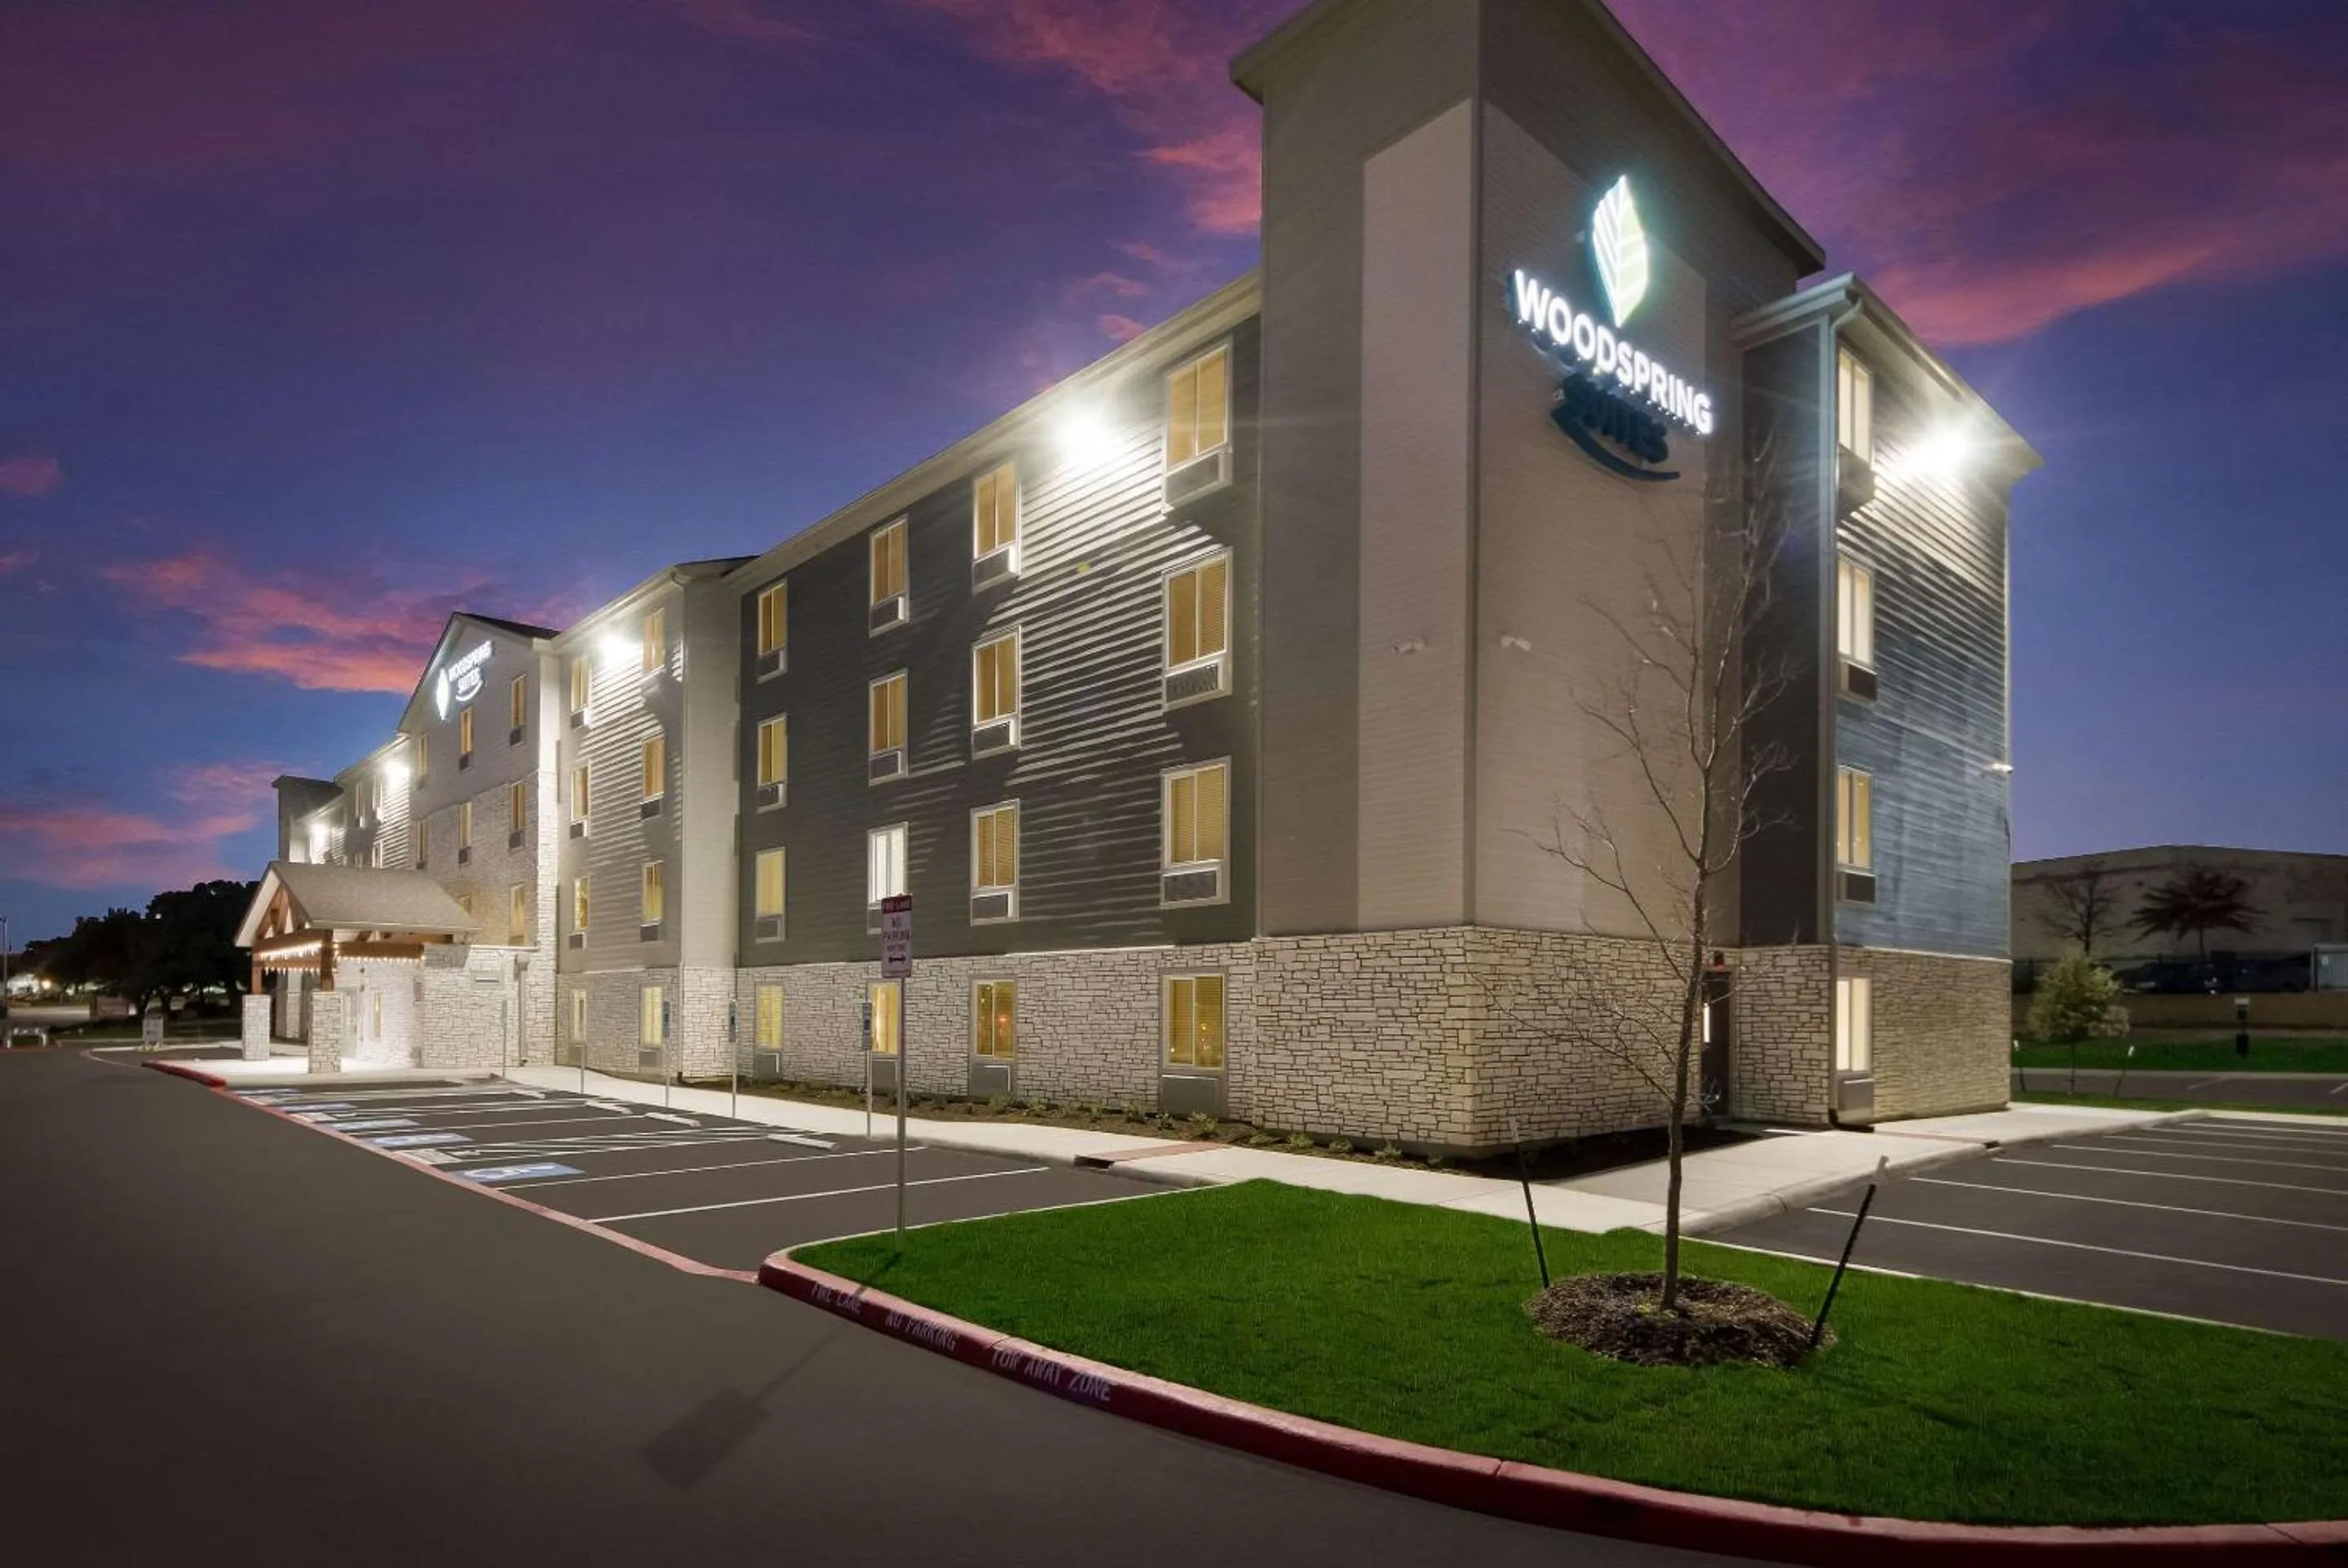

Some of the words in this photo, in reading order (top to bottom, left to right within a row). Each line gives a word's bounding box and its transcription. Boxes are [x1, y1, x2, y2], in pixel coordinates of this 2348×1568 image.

[1514, 269, 1712, 435] WOODSPRING
[905, 1316, 959, 1352] PARKING
[1068, 1371, 1112, 1402] ZONE
